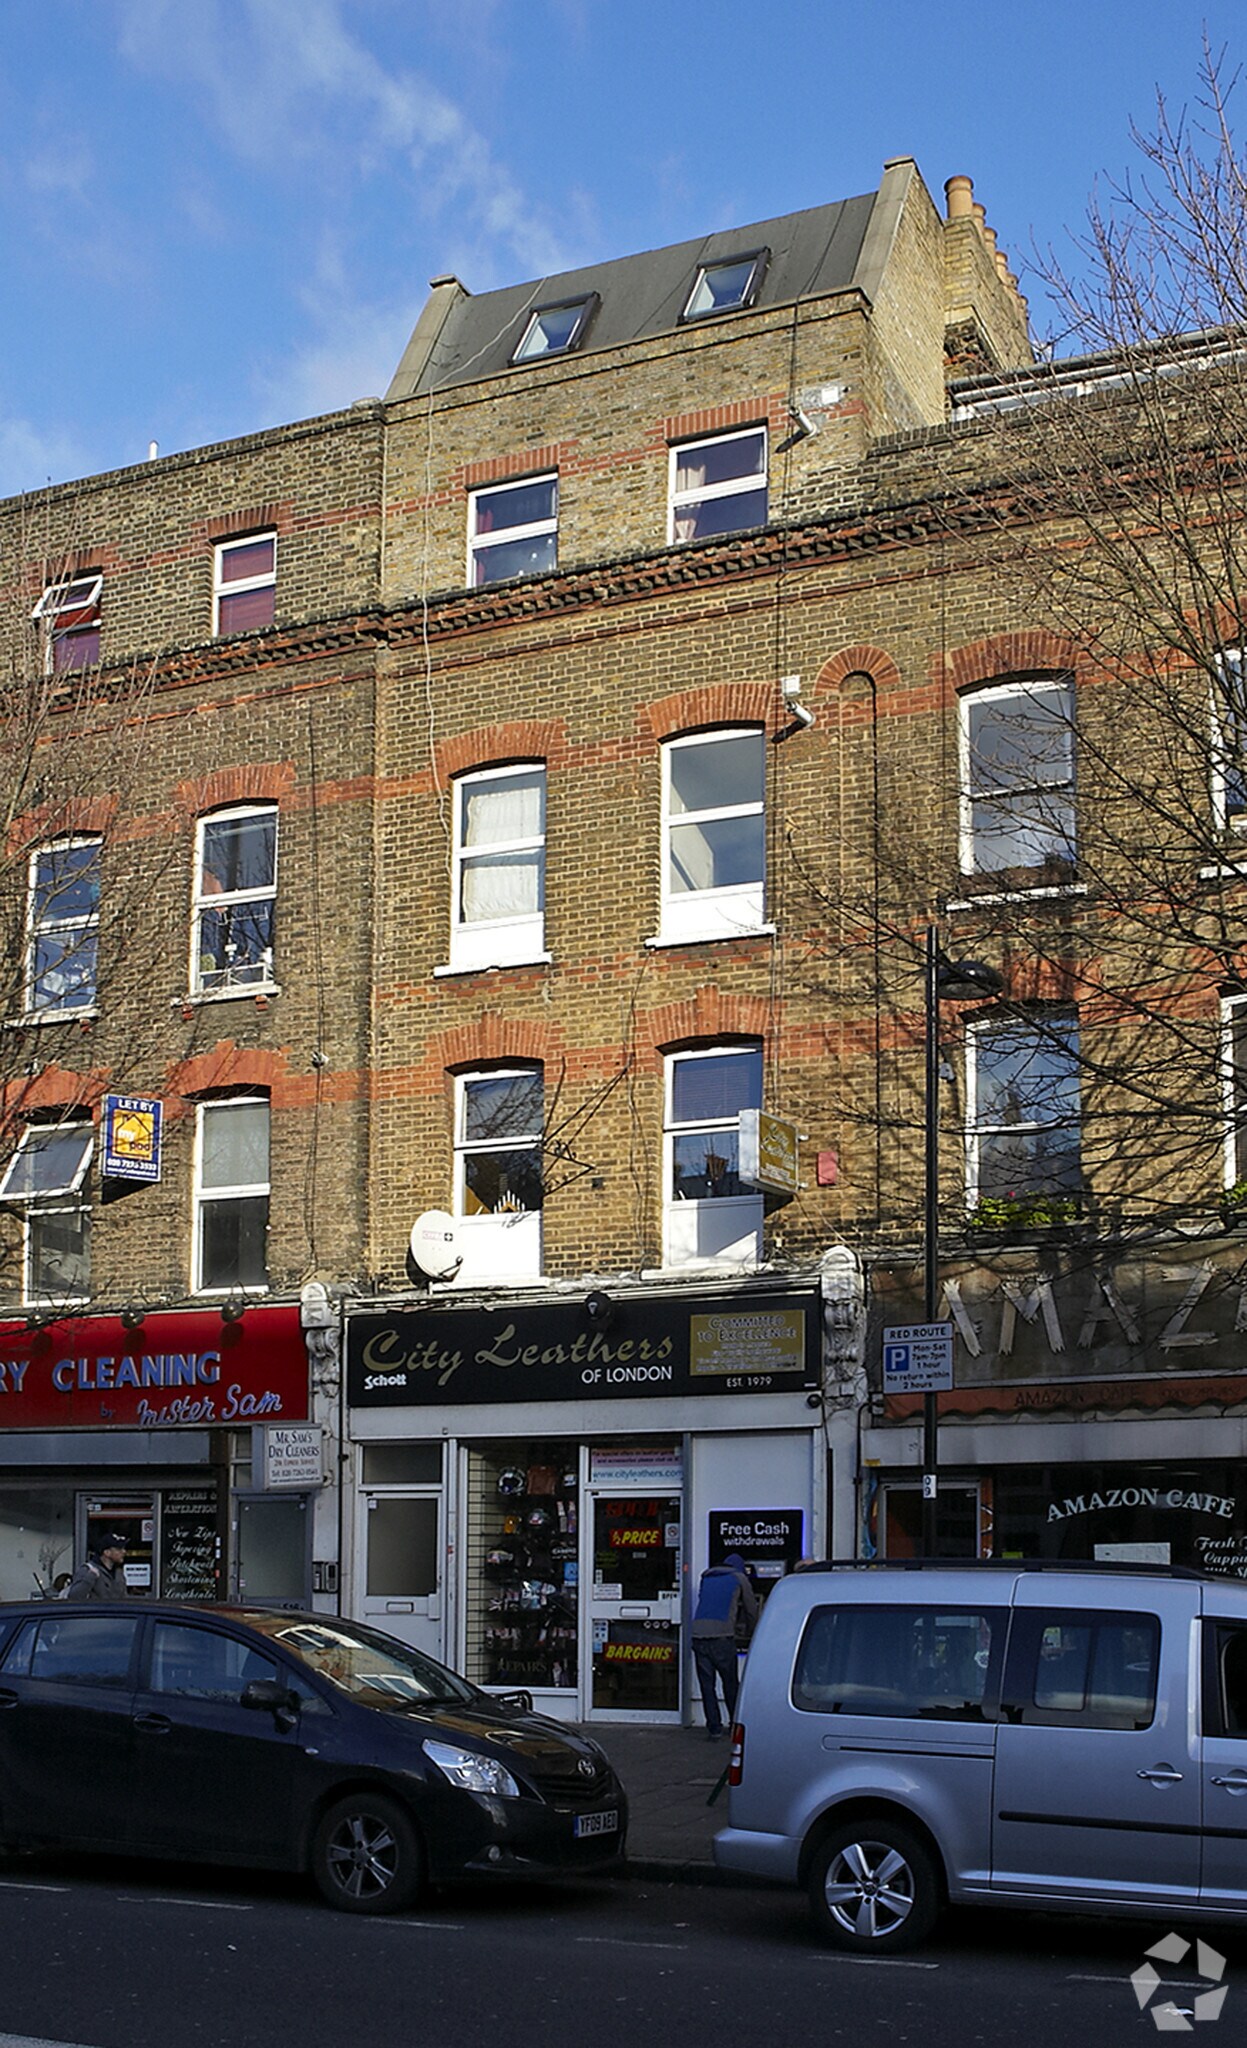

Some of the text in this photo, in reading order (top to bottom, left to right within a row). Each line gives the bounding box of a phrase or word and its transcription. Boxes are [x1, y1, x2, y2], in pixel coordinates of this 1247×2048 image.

[118, 1099, 154, 1112] LET BY
[933, 1257, 1247, 1358] AMAZ
[890, 1327, 946, 1339] RED ROUTE
[913, 1343, 946, 1351] Mon-Sat
[362, 1324, 673, 1386] City Leathers
[891, 1349, 906, 1369] P
[52, 1352, 221, 1392] CLEANING
[923, 1361, 941, 1369] hour
[364, 1373, 407, 1390] Schott
[581, 1366, 672, 1384] OF LONDON
[748, 1376, 772, 1386] 1979
[900, 1373, 924, 1381] return
[926, 1371, 950, 1379] within
[910, 1381, 933, 1389] hours
[221, 1384, 283, 1420] Sam
[1015, 1389, 1084, 1407] AMAZON
[286, 1444, 320, 1458] CLEANERS
[1047, 1488, 1160, 1523] AMAZON
[720, 1521, 789, 1535] Free Cash
[621, 1530, 659, 1544] PRICE
[723, 1536, 785, 1546] withdrawals
[1194, 1536, 1236, 1551] Fresh
[605, 1645, 672, 1660] BARGAINS
[580, 1815, 601, 1833] YF09
